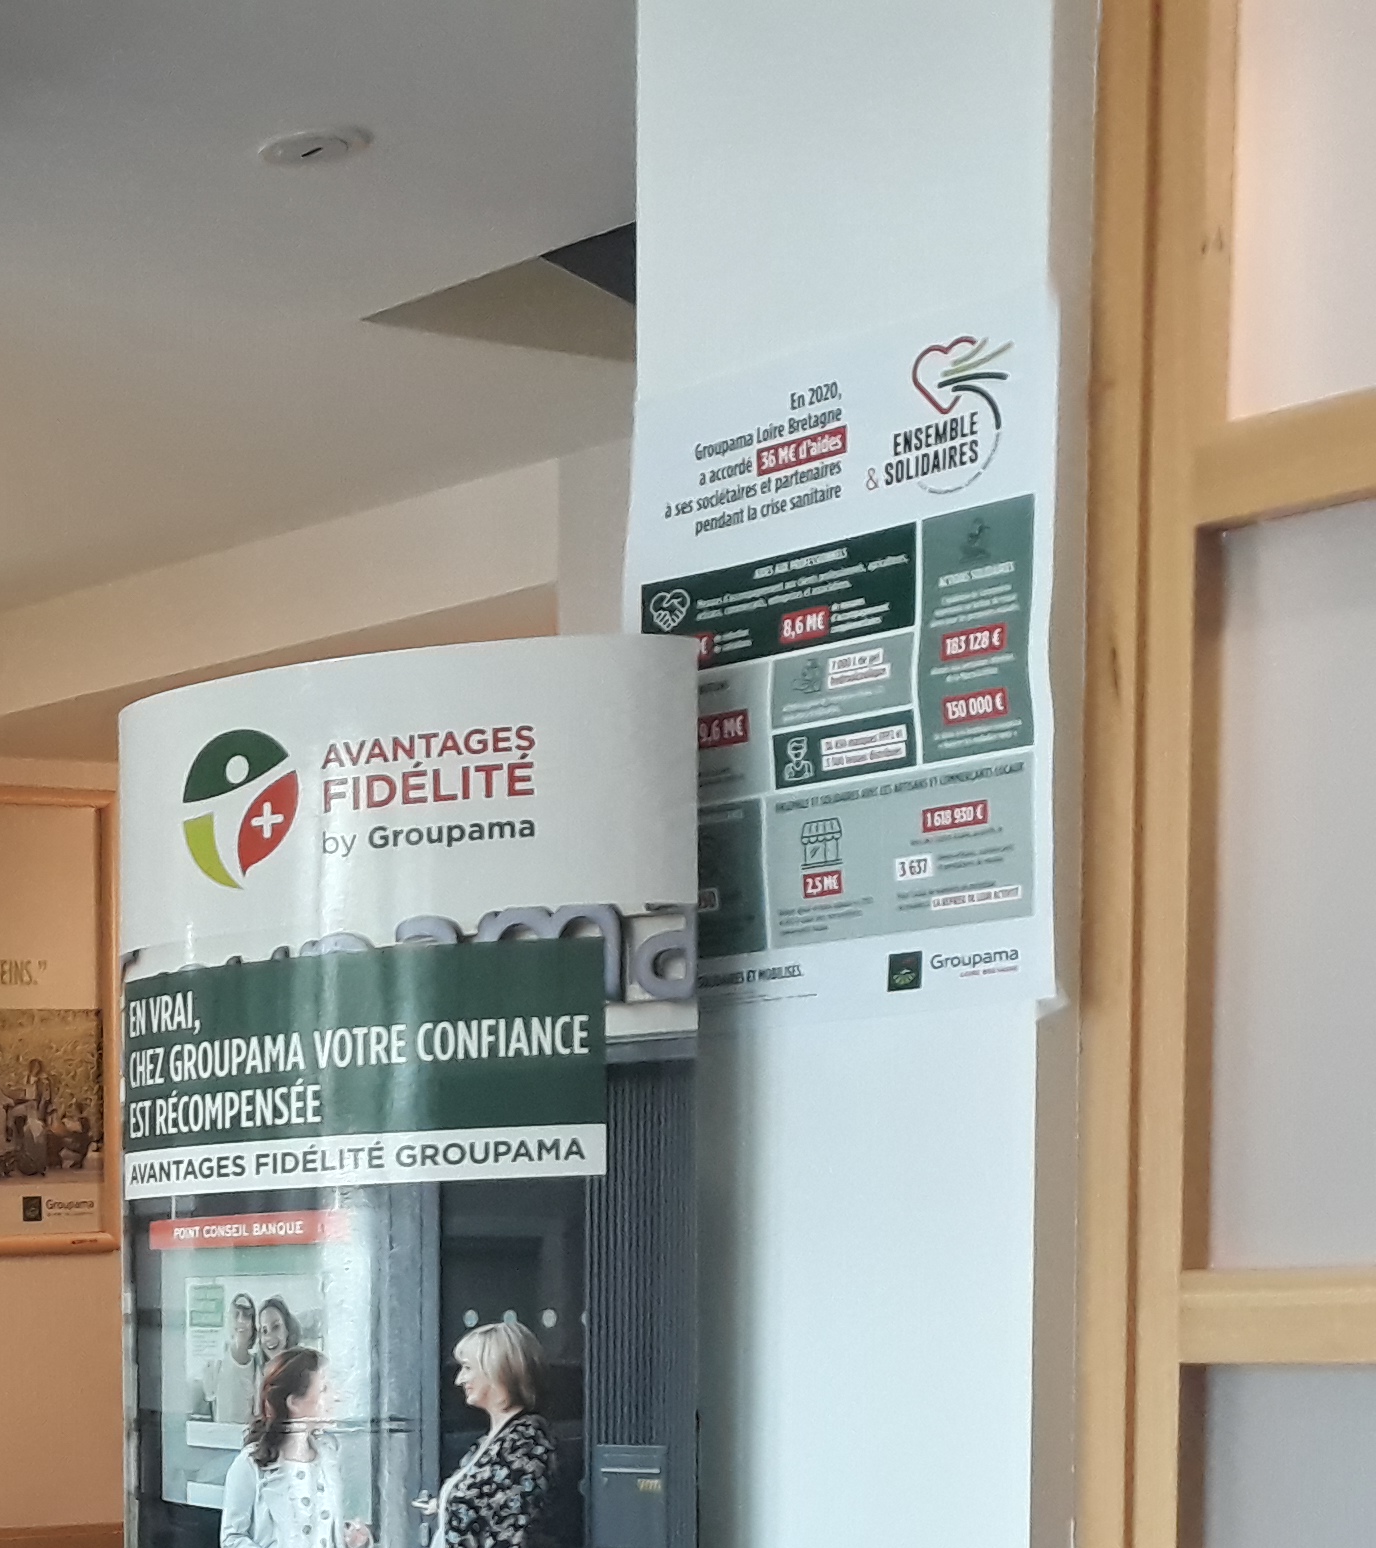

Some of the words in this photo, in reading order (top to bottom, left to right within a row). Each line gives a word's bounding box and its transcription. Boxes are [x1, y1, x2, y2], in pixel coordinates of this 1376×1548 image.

[790, 391, 805, 410] En
[808, 382, 842, 406] 2020,
[695, 433, 754, 460] Groupama
[756, 423, 785, 444] Loire
[788, 408, 842, 436] Bretagne
[893, 411, 979, 456] ENSEMBLE
[708, 459, 753, 485] accordé
[760, 451, 776, 470] 36
[865, 467, 879, 490] &
[885, 440, 979, 486] SOLIDAIRES
[674, 499, 695, 517] ses
[696, 480, 758, 512] sociétaires
[760, 477, 773, 497] et
[775, 461, 842, 496] partenaires
[695, 507, 745, 537] pendant
[747, 504, 758, 521] la
[759, 496, 787, 520] crise
[789, 484, 842, 512] sanitaire
[782, 617, 804, 638] 8,6
[968, 695, 992, 717] 000
[321, 725, 536, 769] AVANTAGES
[321, 754, 535, 813] FIDÉLITÉ
[322, 830, 357, 857] by
[367, 818, 536, 851] Groupama
[930, 949, 1019, 969] Groupama
[128, 1001, 146, 1038] EN
[149, 991, 201, 1036] VRAI,
[129, 1048, 165, 1089] CHEZ
[168, 1031, 306, 1083] GROUPAMA
[313, 1022, 406, 1069] VOTRE
[416, 1013, 590, 1063] CONFIANCE
[129, 1100, 154, 1139] EST
[155, 1079, 322, 1135] RÉCOMPENSÉE
[128, 1153, 246, 1187] AVANTAGES
[254, 1140, 385, 1178] FIDÉLITÉ
[395, 1136, 586, 1169] GROUPAMA
[173, 1225, 200, 1240] POINT
[202, 1223, 249, 1238] CONSEIL
[251, 1220, 304, 1237] BANQUE
